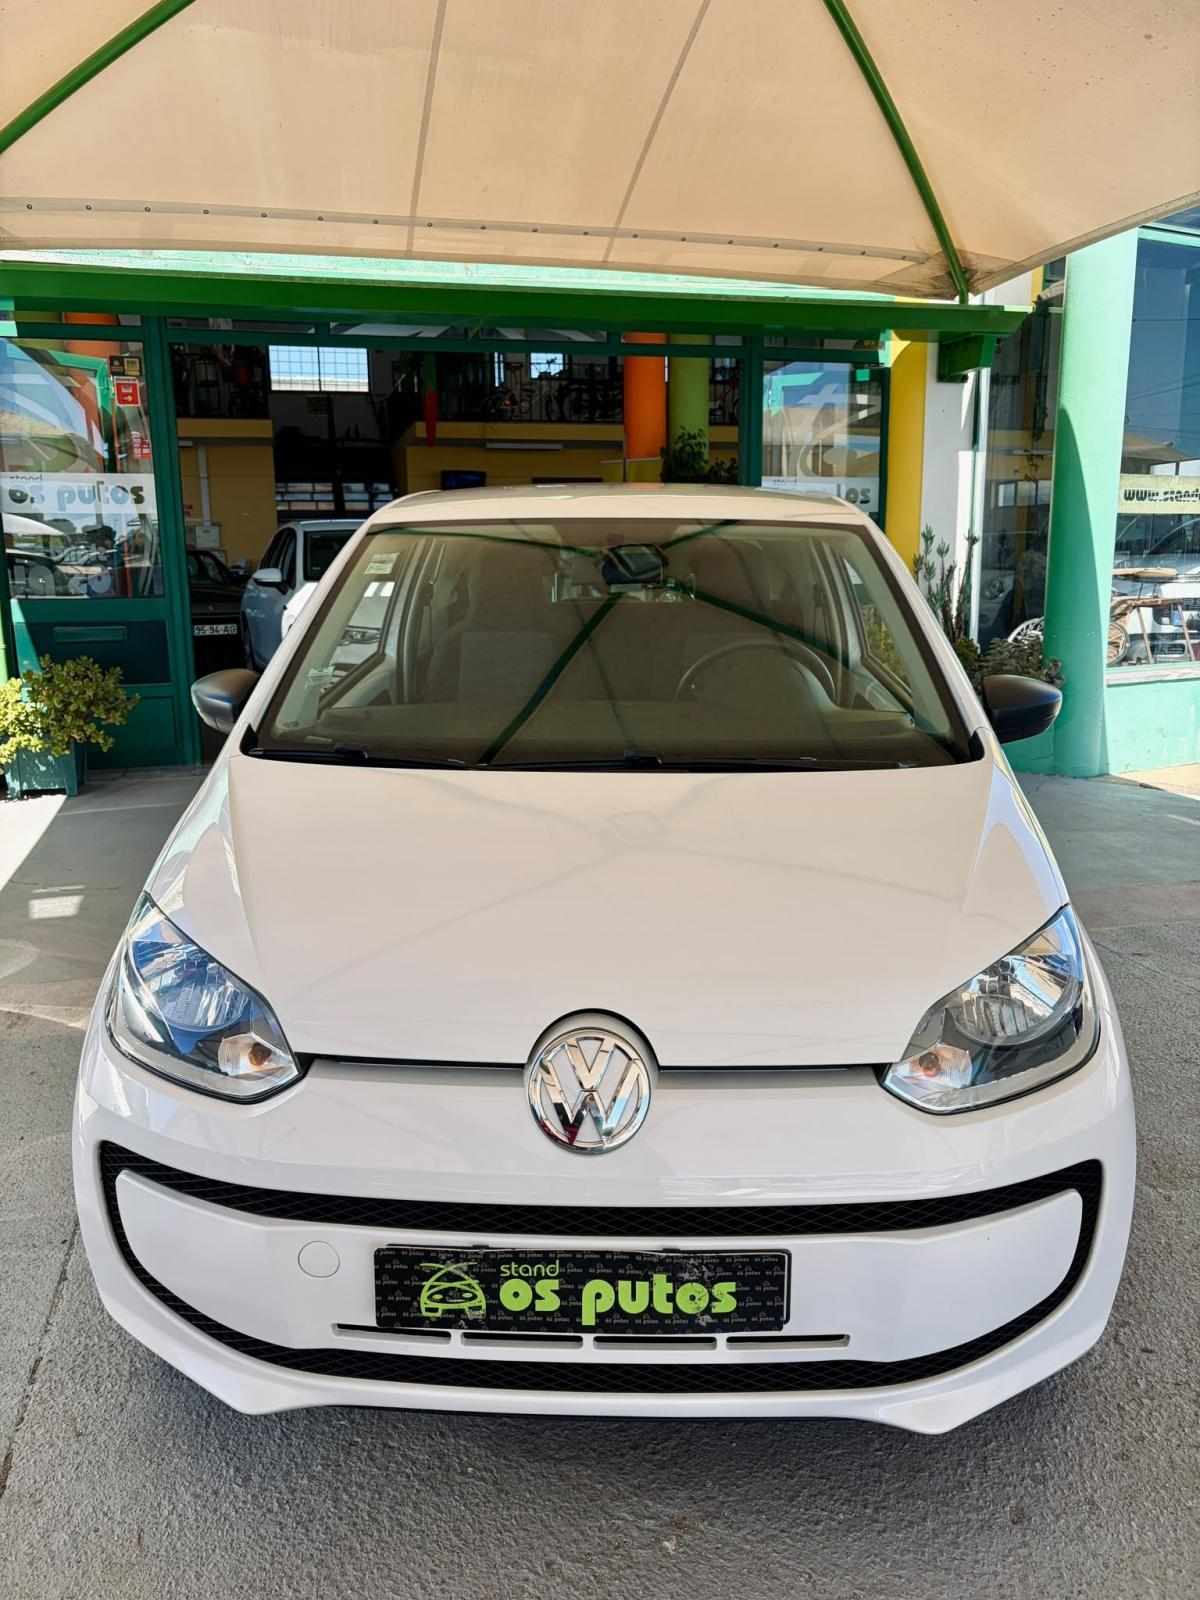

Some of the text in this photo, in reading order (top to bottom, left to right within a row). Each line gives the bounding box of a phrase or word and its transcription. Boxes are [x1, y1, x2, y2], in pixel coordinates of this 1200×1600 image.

[499, 1259, 560, 1277] stand
[499, 1273, 737, 1326] os putos
